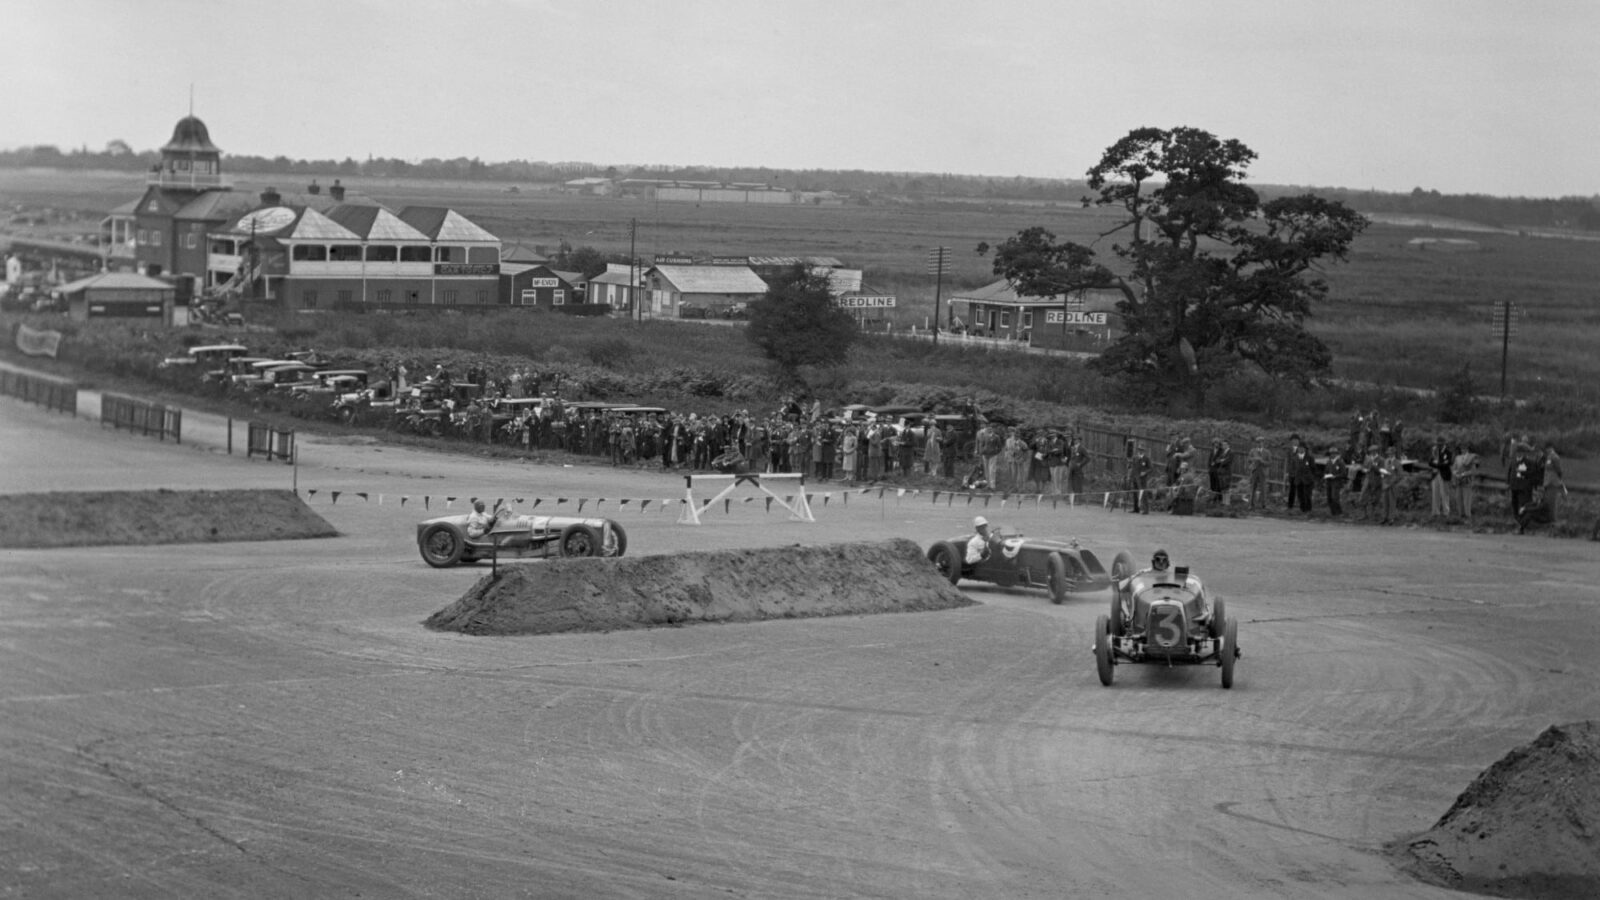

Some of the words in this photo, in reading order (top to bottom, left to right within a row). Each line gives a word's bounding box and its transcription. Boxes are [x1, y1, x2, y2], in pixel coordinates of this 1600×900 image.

[840, 297, 893, 307] REDLINE
[1047, 312, 1104, 323] REDLINE
[1002, 538, 1024, 558] 9
[1155, 605, 1181, 647] 3
